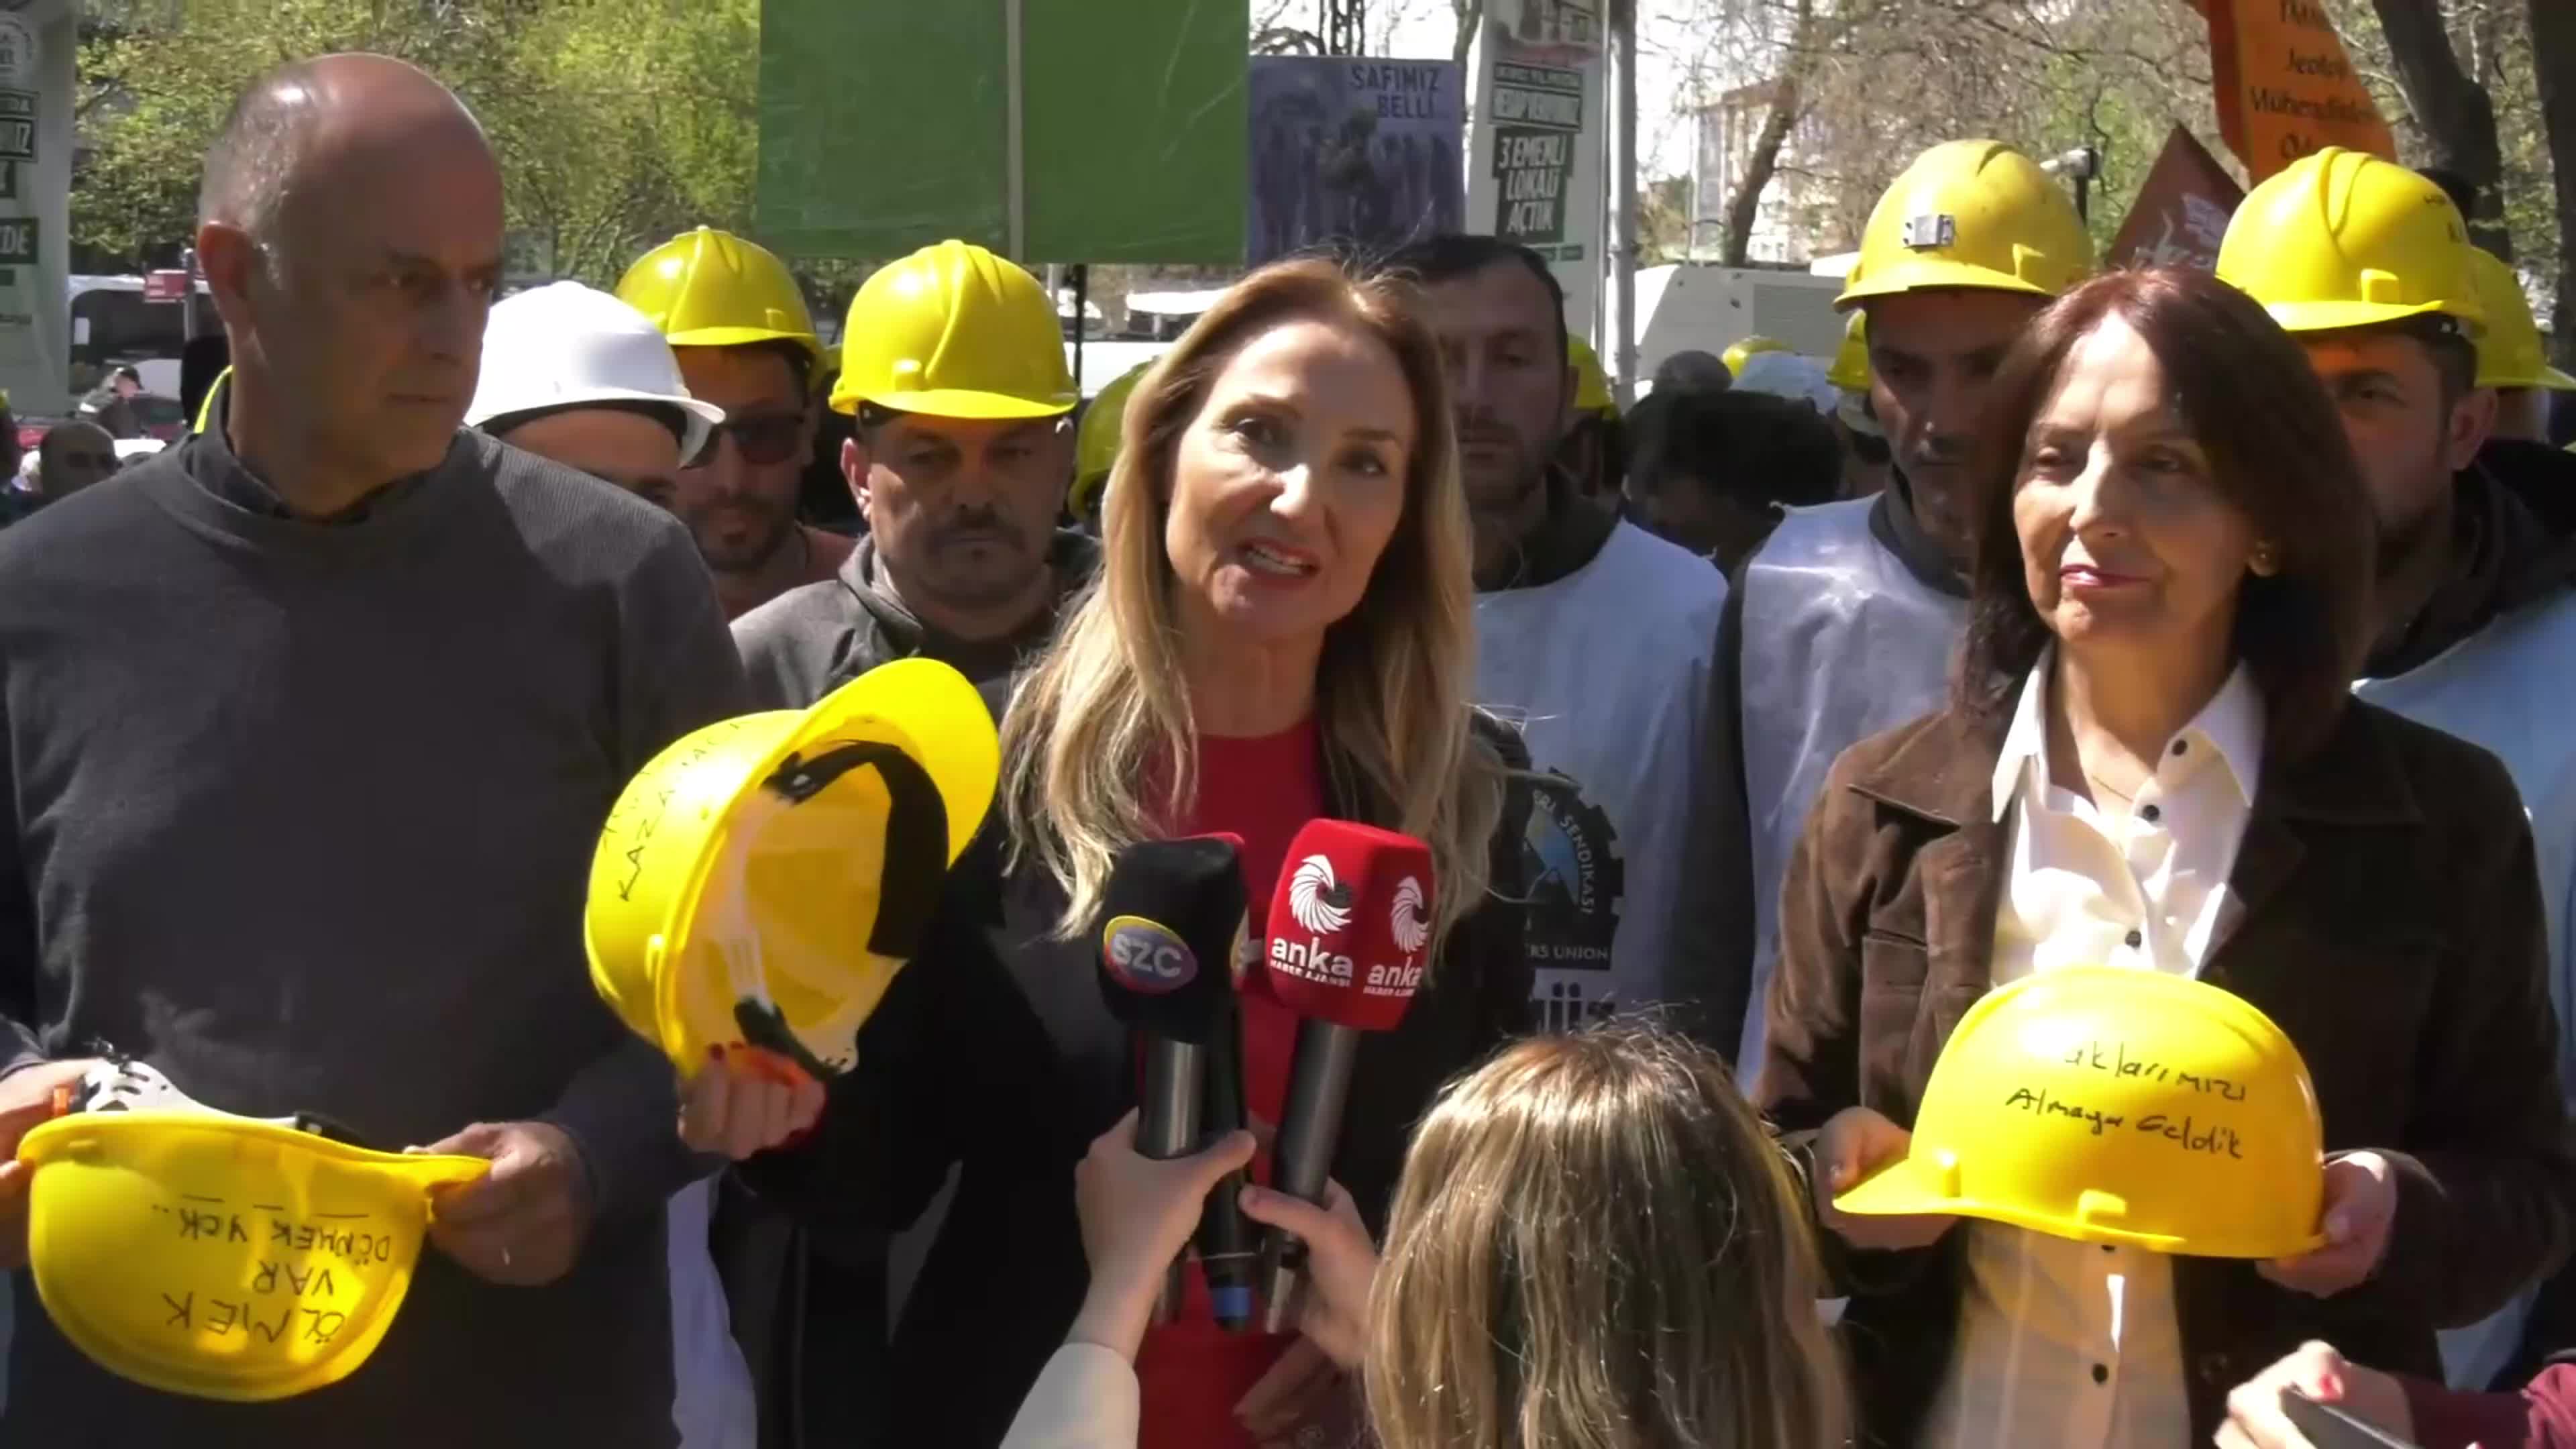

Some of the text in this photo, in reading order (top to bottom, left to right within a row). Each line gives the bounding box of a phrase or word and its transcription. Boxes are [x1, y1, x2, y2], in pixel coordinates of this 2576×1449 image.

[1111, 933, 1182, 977] SZC
[1271, 936, 1353, 977] anka
[1553, 945, 1608, 961] UNION
[252, 1260, 334, 1296] VAR
